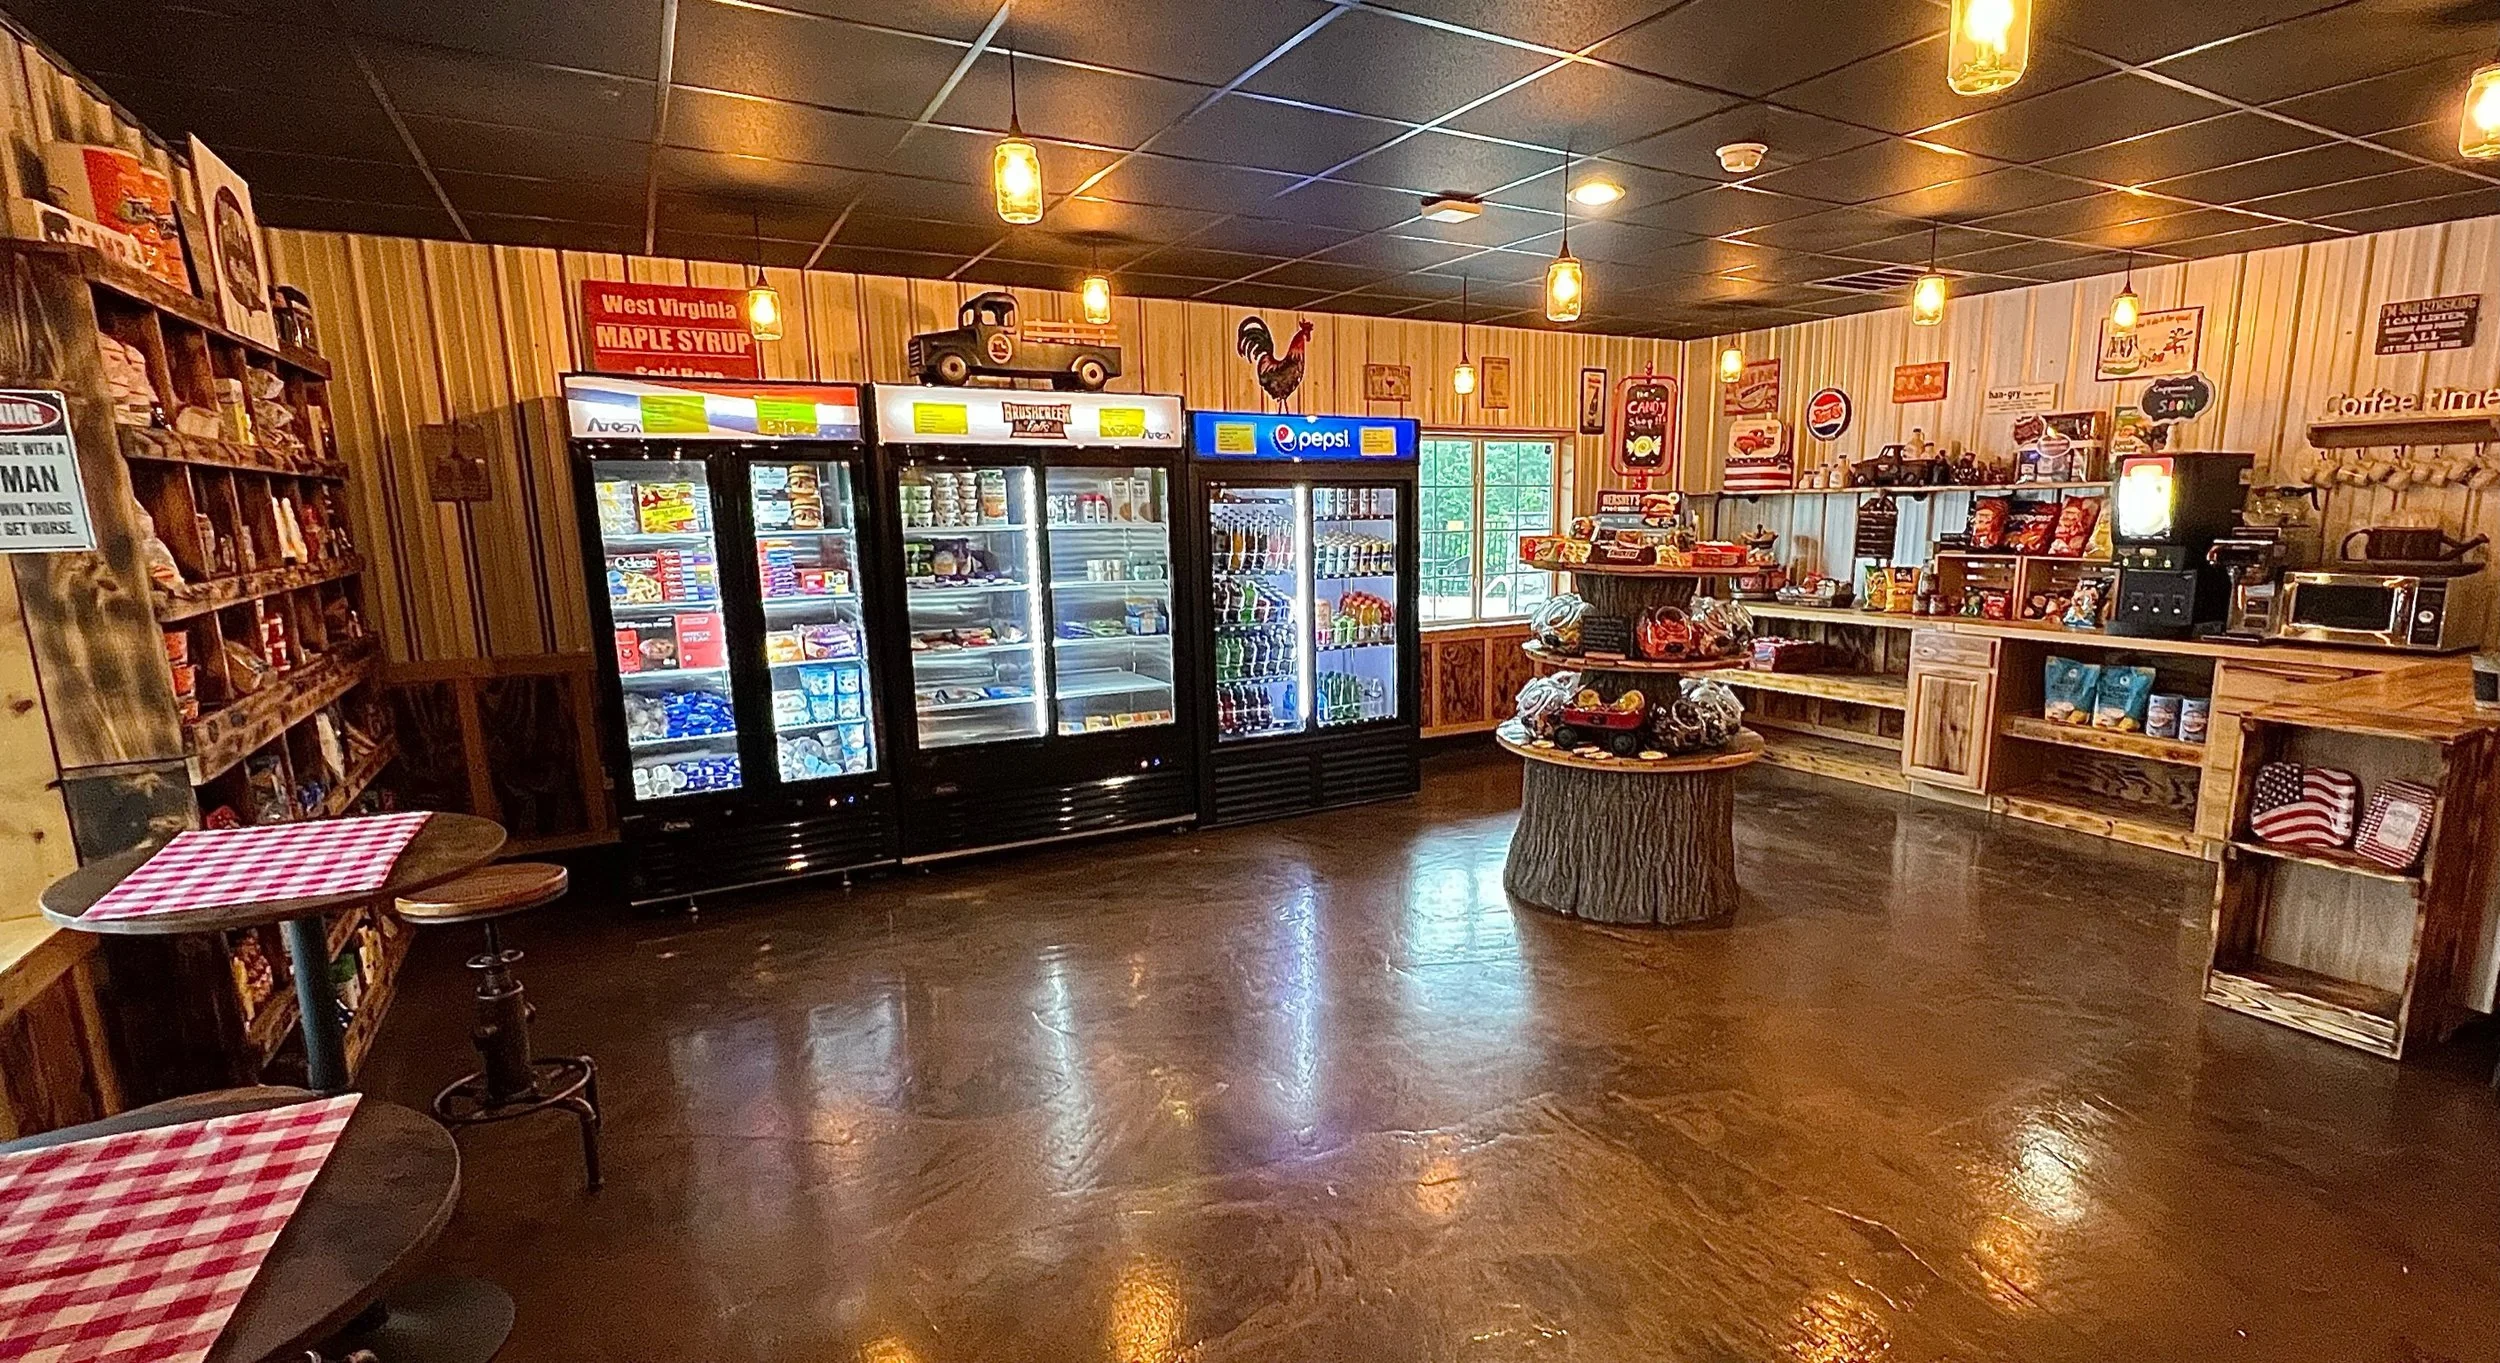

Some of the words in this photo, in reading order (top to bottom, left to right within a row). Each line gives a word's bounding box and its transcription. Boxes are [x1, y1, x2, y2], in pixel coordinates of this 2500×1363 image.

[602, 294, 657, 315] West
[658, 298, 737, 319] Virginia
[2393, 315, 2419, 325] CAN
[596, 325, 674, 351] MAPLE
[676, 330, 751, 354] SYRUP
[2405, 331, 2441, 343] ALL
[1627, 401, 1667, 415] CANDY
[2158, 399, 2197, 413] SOON
[2326, 388, 2418, 415] Coffee
[1004, 403, 1072, 424] BRUSHCREEK
[1299, 429, 1349, 451] pepsi
[22, 442, 54, 455] WITH
[56, 442, 66, 455] A
[0, 465, 60, 493] MAN
[26, 502, 73, 516] THINGS
[4, 522, 27, 536] GET
[614, 557, 657, 570] Celeste
